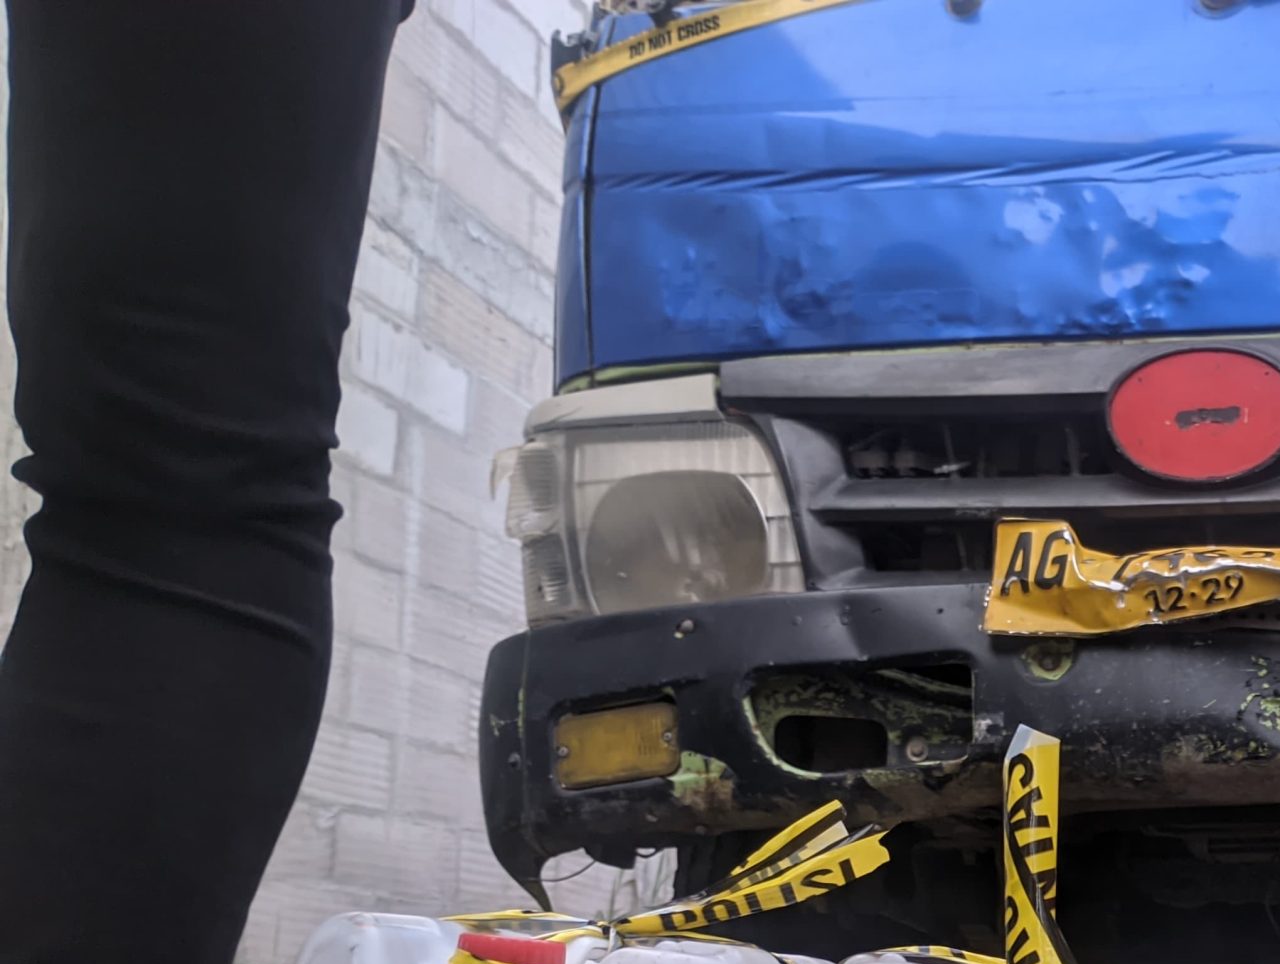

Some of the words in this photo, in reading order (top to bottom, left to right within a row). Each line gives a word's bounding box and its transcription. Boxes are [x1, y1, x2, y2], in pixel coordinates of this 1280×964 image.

[629, 44, 646, 60] DO
[648, 31, 673, 53] NOT
[677, 15, 721, 42] CROSS
[1000, 529, 1071, 597] AG
